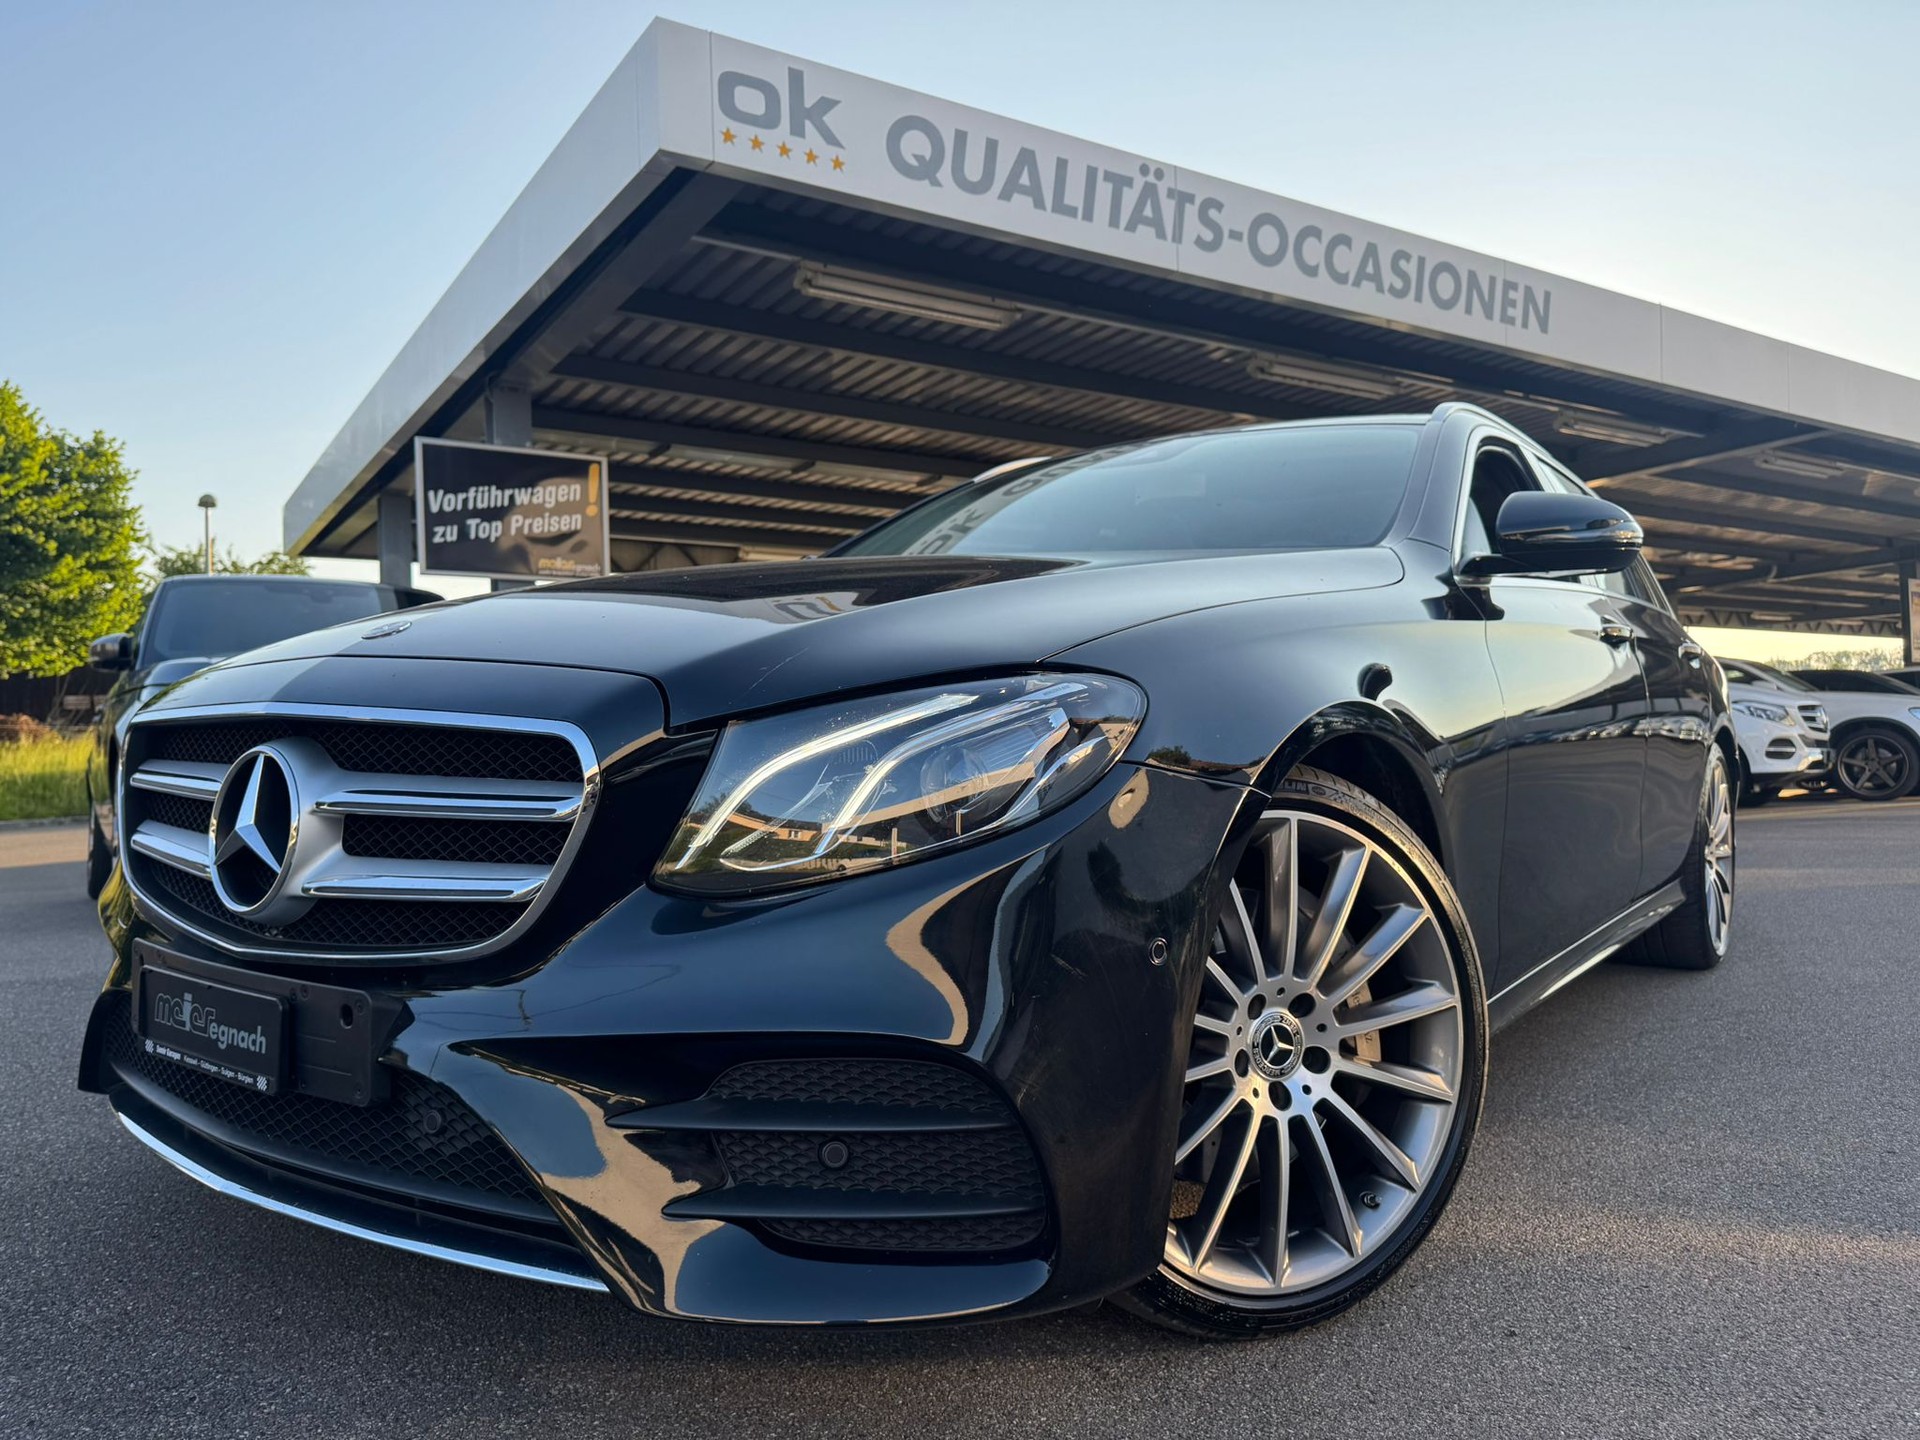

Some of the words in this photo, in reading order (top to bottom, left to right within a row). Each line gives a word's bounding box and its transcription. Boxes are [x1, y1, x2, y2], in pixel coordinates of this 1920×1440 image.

[717, 66, 845, 150] ok
[885, 114, 1552, 335] QUALITÄTS-OCCASIONEN
[427, 483, 581, 513] Vorführwagen
[432, 525, 458, 544] zu
[466, 518, 503, 543] Top
[510, 513, 582, 536] Preisen
